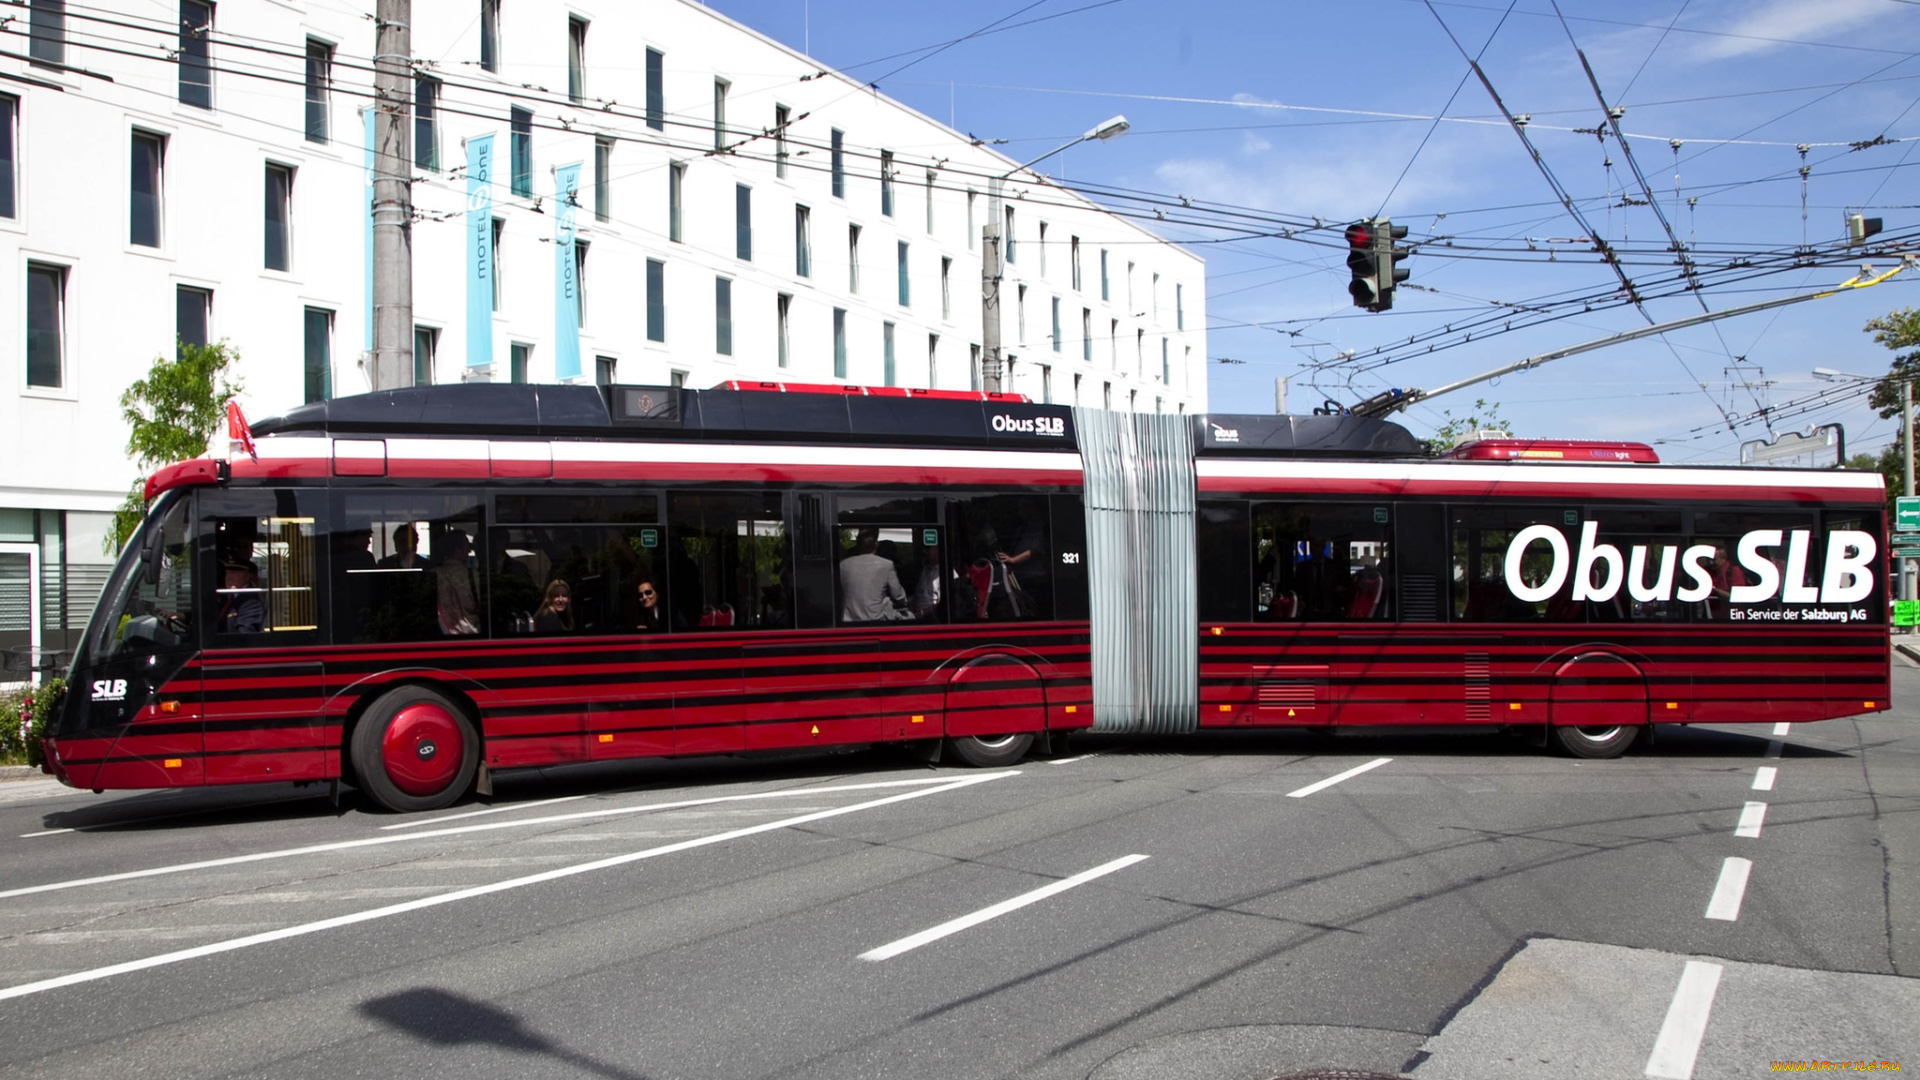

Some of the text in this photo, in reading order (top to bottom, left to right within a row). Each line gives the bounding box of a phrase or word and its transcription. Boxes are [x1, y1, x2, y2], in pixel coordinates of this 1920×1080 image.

[478, 143, 488, 183] ONE
[991, 414, 1065, 433] Obus SLB
[1062, 552, 1080, 564] 321
[1503, 520, 1878, 604] Obus SLB
[1730, 608, 1867, 623] Ein Service der Salzburg AG
[91, 678, 128, 698] SLB
